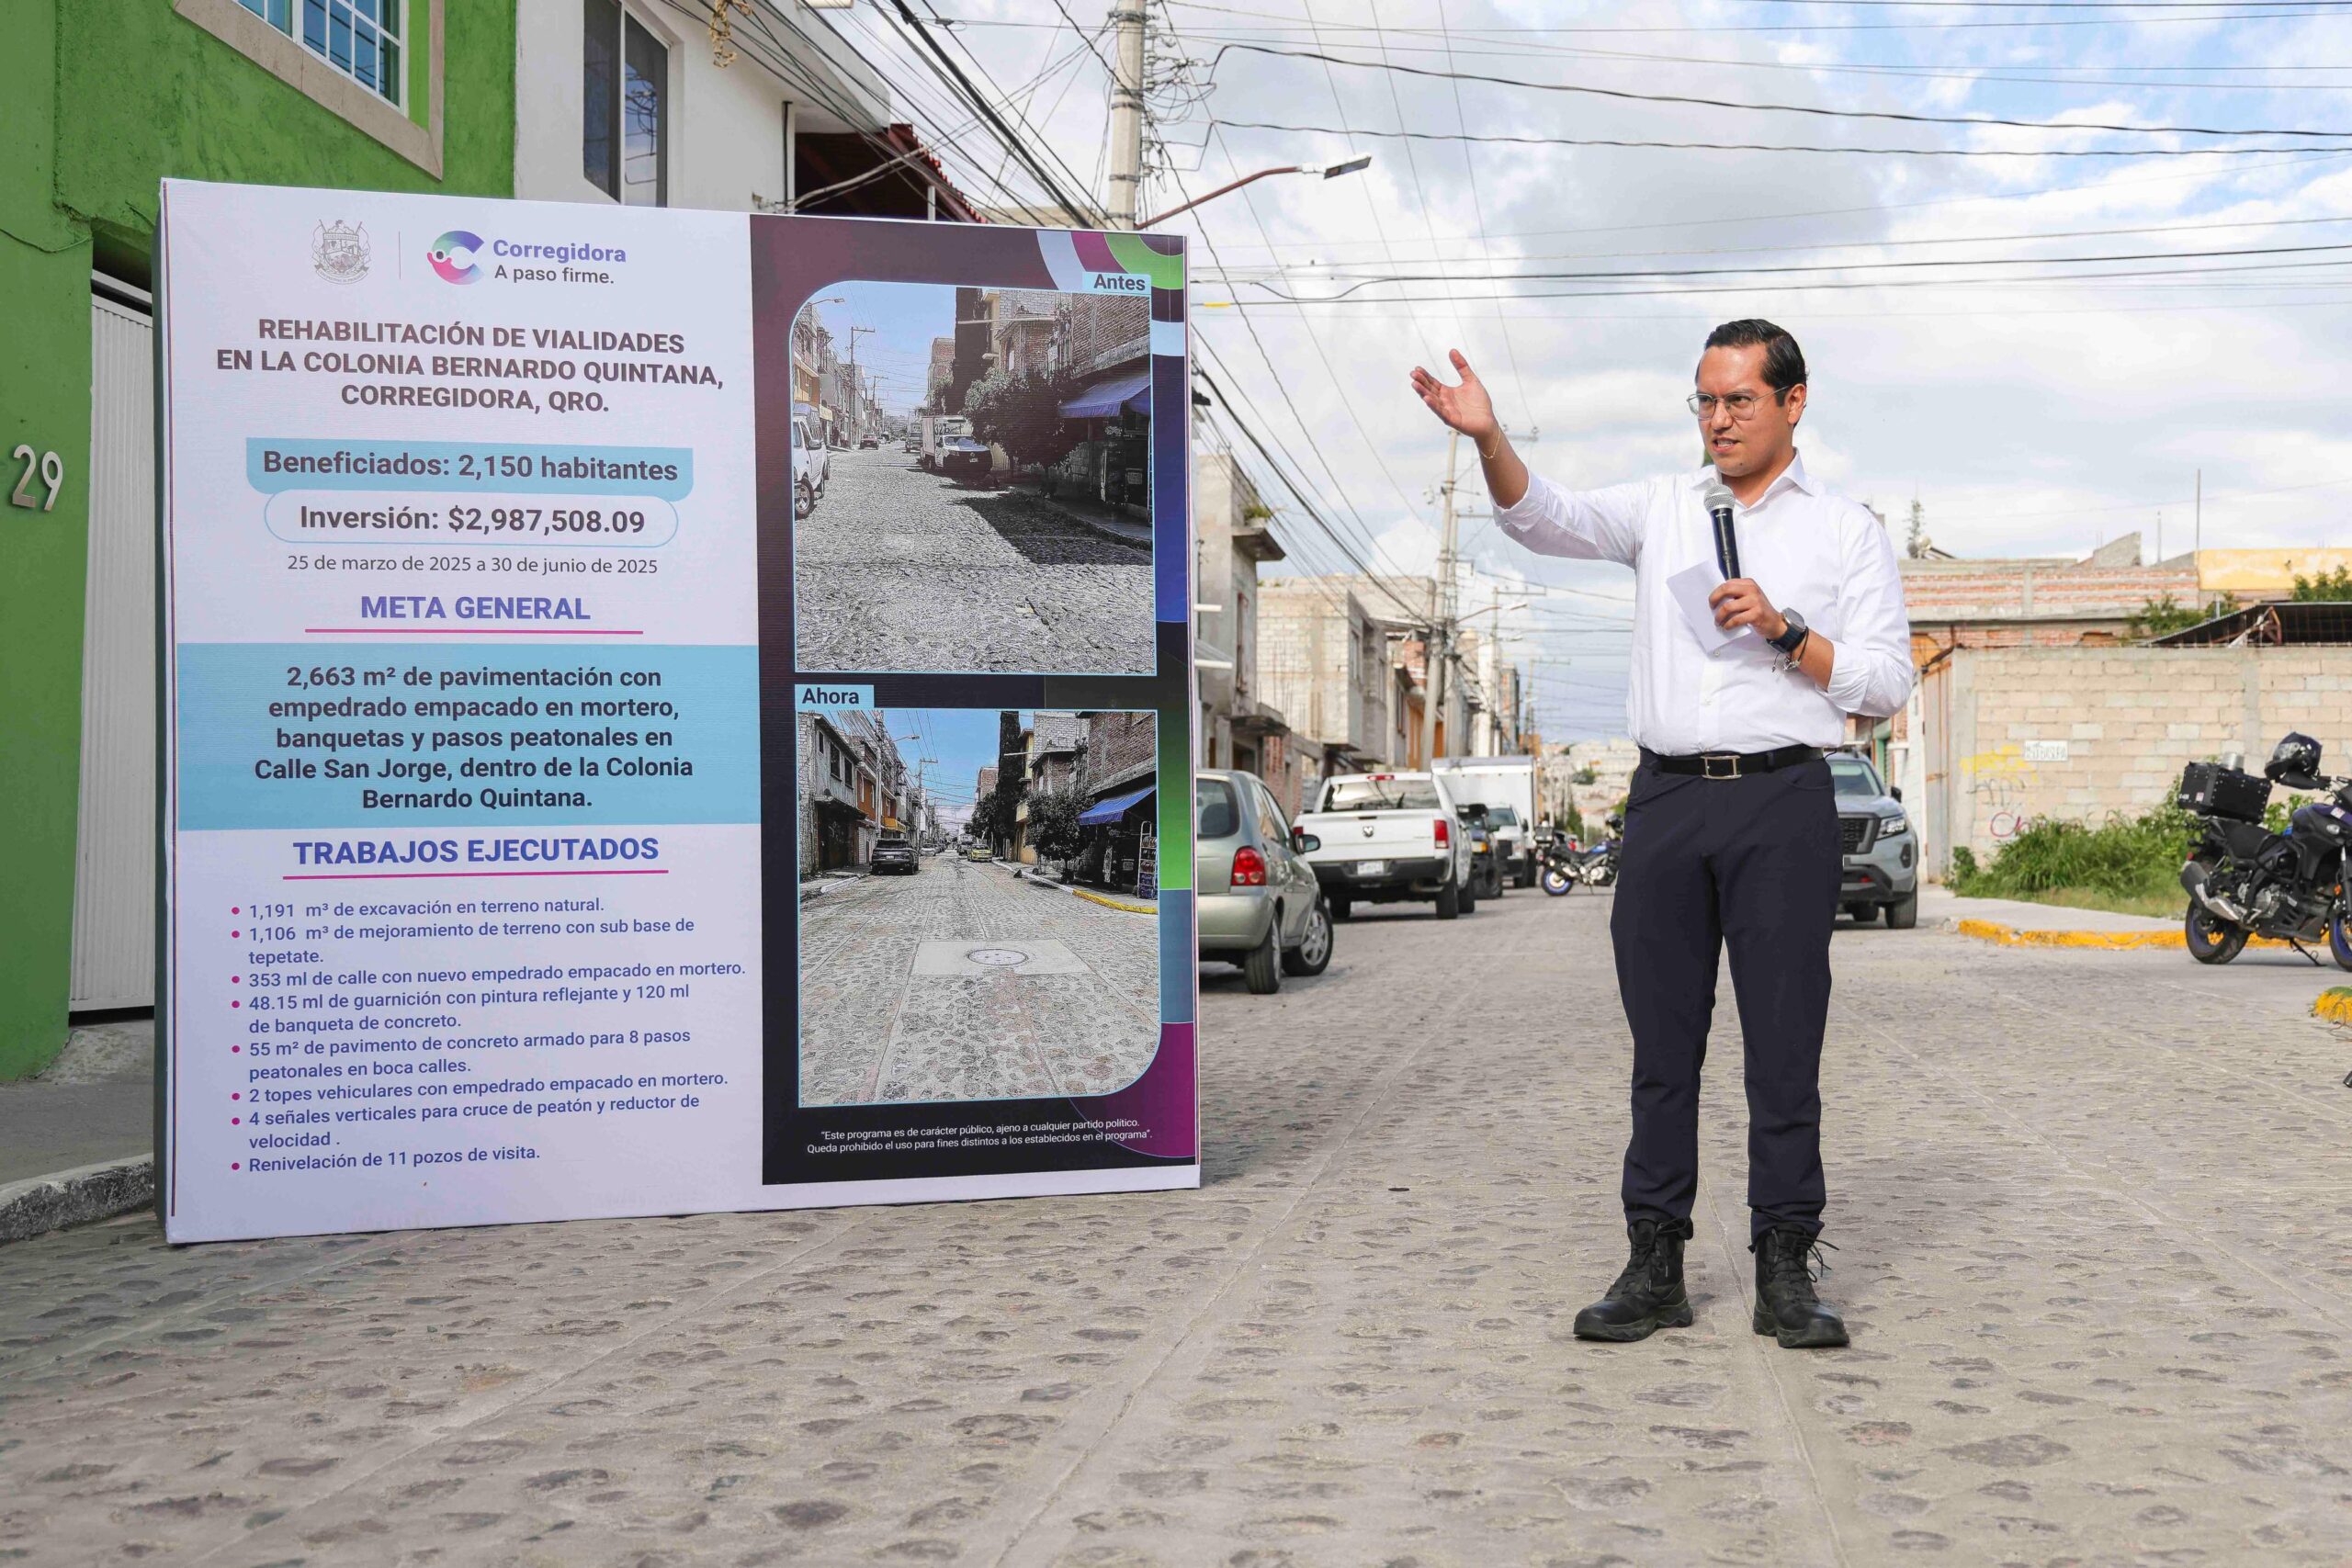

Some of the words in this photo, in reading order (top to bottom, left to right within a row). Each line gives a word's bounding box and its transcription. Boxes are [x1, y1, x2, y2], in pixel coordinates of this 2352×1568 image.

[493, 240, 626, 263] Corregidora
[494, 265, 507, 278] A
[514, 268, 556, 283] paso
[562, 266, 613, 283] firme.
[1093, 274, 1145, 290] Antes
[259, 319, 483, 345] REHABILITACIÓN
[492, 327, 525, 346] DE
[532, 329, 684, 353] VIALIDADES
[217, 349, 252, 369] EN
[262, 350, 296, 370] LA
[304, 352, 424, 375] COLONIA
[433, 355, 575, 379] BERNARDO
[583, 361, 722, 389] QUINTANA,
[342, 385, 539, 413] CORREGIDORA,
[548, 390, 608, 412] QRO.
[264, 450, 448, 475] Beneficiados:
[458, 455, 532, 479] 2,150
[541, 456, 677, 480] habitantes
[13, 445, 63, 512] 29
[301, 506, 437, 529] Inversión:
[448, 504, 643, 536] $2,987,508.09
[288, 555, 308, 570] 25
[314, 555, 335, 570] de
[342, 558, 396, 570] marzo
[402, 556, 424, 570] de
[430, 557, 470, 570] 2025
[492, 558, 511, 571] 30
[516, 557, 537, 571] de
[542, 558, 585, 575] junio
[591, 558, 612, 572] de
[617, 559, 657, 573] 2025
[361, 596, 446, 618] META
[455, 596, 590, 619] GENERAL
[288, 667, 355, 689] 2,663
[403, 666, 432, 685] de
[440, 666, 612, 690] pavimentación
[620, 671, 661, 685] con
[802, 687, 858, 704] Ahora
[269, 696, 406, 721] empedrado
[414, 696, 537, 721] empacado
[546, 702, 572, 716] en
[582, 699, 678, 719] mortero,
[277, 728, 403, 751] banquetas
[412, 732, 424, 751] y
[433, 732, 502, 751] pasos
[511, 727, 638, 750] peatonales
[645, 732, 672, 746] en
[255, 759, 316, 778] Calle
[324, 759, 368, 778] San
[377, 759, 451, 782] Jorge,
[460, 757, 536, 777] dentro
[544, 757, 571, 776] de
[580, 756, 598, 776] la
[606, 756, 692, 776] Colonia
[363, 788, 472, 807] Bernardo
[480, 787, 592, 809] Quintana.
[293, 840, 458, 863] TRABAJOS
[468, 838, 658, 861] EJECUTADOS
[250, 904, 292, 919] 1,191
[359, 900, 450, 915] excavación
[457, 903, 475, 913] en
[481, 901, 538, 912] terreno
[545, 897, 604, 911] natural.
[250, 927, 295, 942] 1,106
[359, 923, 473, 942] mejoramiento
[503, 923, 560, 934] terreno
[566, 923, 594, 933] con
[600, 919, 628, 932] sub
[633, 919, 670, 931] base
[248, 951, 322, 966] tepetate.
[249, 973, 280, 987] 353
[287, 972, 306, 986] ml
[338, 970, 376, 984] calle
[382, 973, 411, 983] con
[418, 971, 466, 982] nuevo
[471, 965, 562, 983] empedrado
[569, 963, 650, 981] empacado
[656, 965, 673, 976] en
[680, 963, 744, 975] mortero.
[249, 995, 297, 1010] 48.15
[303, 994, 322, 1008] ml
[329, 993, 348, 1008] de
[354, 991, 440, 1010] guarnición
[447, 993, 475, 1004] con
[481, 989, 537, 1006] pintura
[543, 987, 617, 1004] reflejante
[637, 985, 664, 998] 120
[671, 984, 688, 997] ml
[249, 1019, 269, 1032] de
[276, 1018, 353, 1034] banqueta
[359, 1016, 379, 1029] de
[384, 1015, 460, 1028] concreto.
[250, 1043, 270, 1055] 55
[304, 1040, 323, 1054] de
[330, 1039, 416, 1056] pavimento
[423, 1036, 441, 1050] de
[447, 1035, 518, 1049] concreto
[524, 1032, 584, 1046] armado
[590, 1033, 623, 1047] para
[629, 1030, 638, 1043] 8
[644, 1032, 690, 1045] pasos
[250, 1063, 342, 1082] peatonales
[348, 1066, 367, 1076] en
[373, 1061, 413, 1075] boca
[419, 1058, 470, 1073] calles.
[250, 1089, 259, 1101] 2
[265, 1089, 311, 1104] topes
[317, 1083, 412, 1099] vehiculares
[418, 1085, 447, 1095] con
[453, 1077, 544, 1096] empedrado
[549, 1075, 632, 1092] empacado
[638, 1077, 656, 1087] en
[662, 1073, 727, 1086] mortero.
[249, 1111, 259, 1124] 4
[265, 1109, 330, 1124] señales
[335, 1105, 415, 1121] verticales
[422, 1107, 457, 1121] para
[463, 1105, 507, 1116] cruce
[513, 1100, 532, 1113] de
[537, 1098, 591, 1116] peatón
[610, 1096, 675, 1110] reductor
[681, 1094, 699, 1107] de
[249, 1132, 330, 1148] velocidad
[847, 1131, 891, 1140] programa
[921, 1126, 957, 1135] carácter
[959, 1125, 993, 1135] público,
[996, 1125, 1020, 1134] ajeno
[1030, 1122, 1070, 1132] cualquier
[1073, 1120, 1103, 1131] partido
[1106, 1119, 1139, 1129] político.
[808, 1144, 837, 1153] Queda
[840, 1142, 883, 1153] prohibido
[914, 1141, 933, 1150] para
[1024, 1134, 1080, 1143] establecidos
[250, 1154, 356, 1171] Renivelación
[362, 1152, 381, 1166] de
[389, 1152, 404, 1165] 11
[413, 1152, 462, 1167] pozos
[468, 1147, 487, 1161] de
[492, 1145, 539, 1159] visita.
